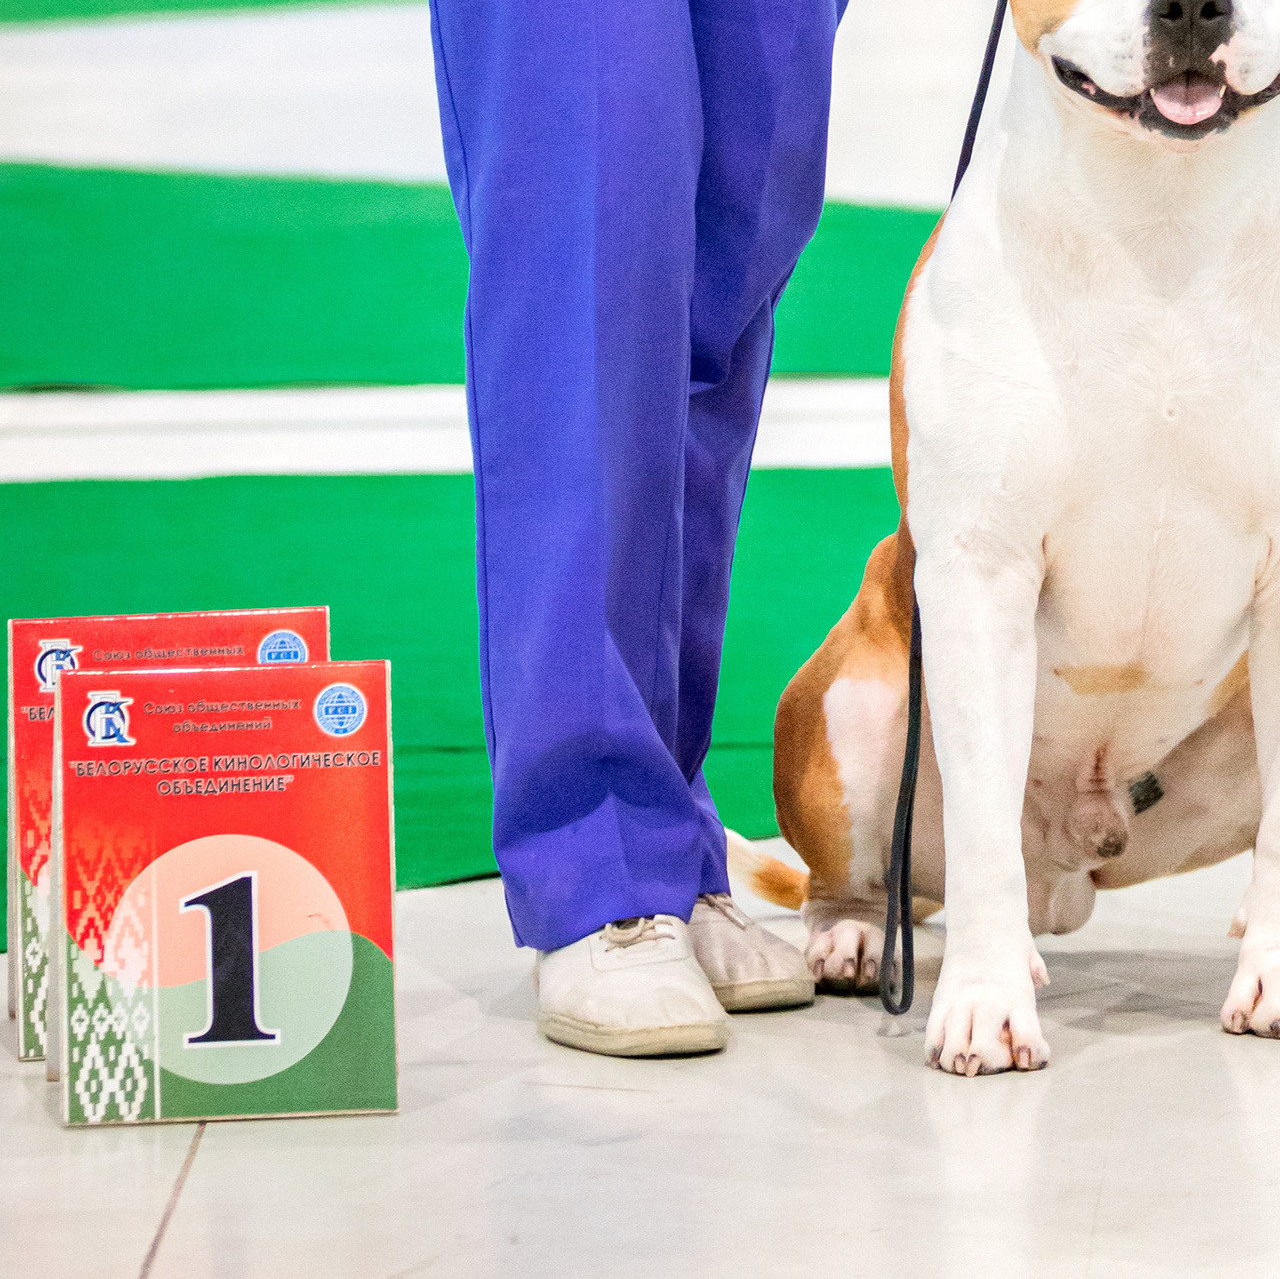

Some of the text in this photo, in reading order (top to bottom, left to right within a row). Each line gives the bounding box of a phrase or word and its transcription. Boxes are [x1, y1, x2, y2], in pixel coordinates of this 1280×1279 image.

[93, 645, 244, 661] Союз общественных
[144, 698, 301, 715] Союз общественных
[172, 716, 272, 733] объединений
[69, 751, 380, 777] "БЕЛОРУССКОЕ КИНОЛОГИЧЕСКОЕ
[158, 776, 294, 796] ОБЪЕДИНЕНИЕ"
[182, 873, 278, 1046] 1
